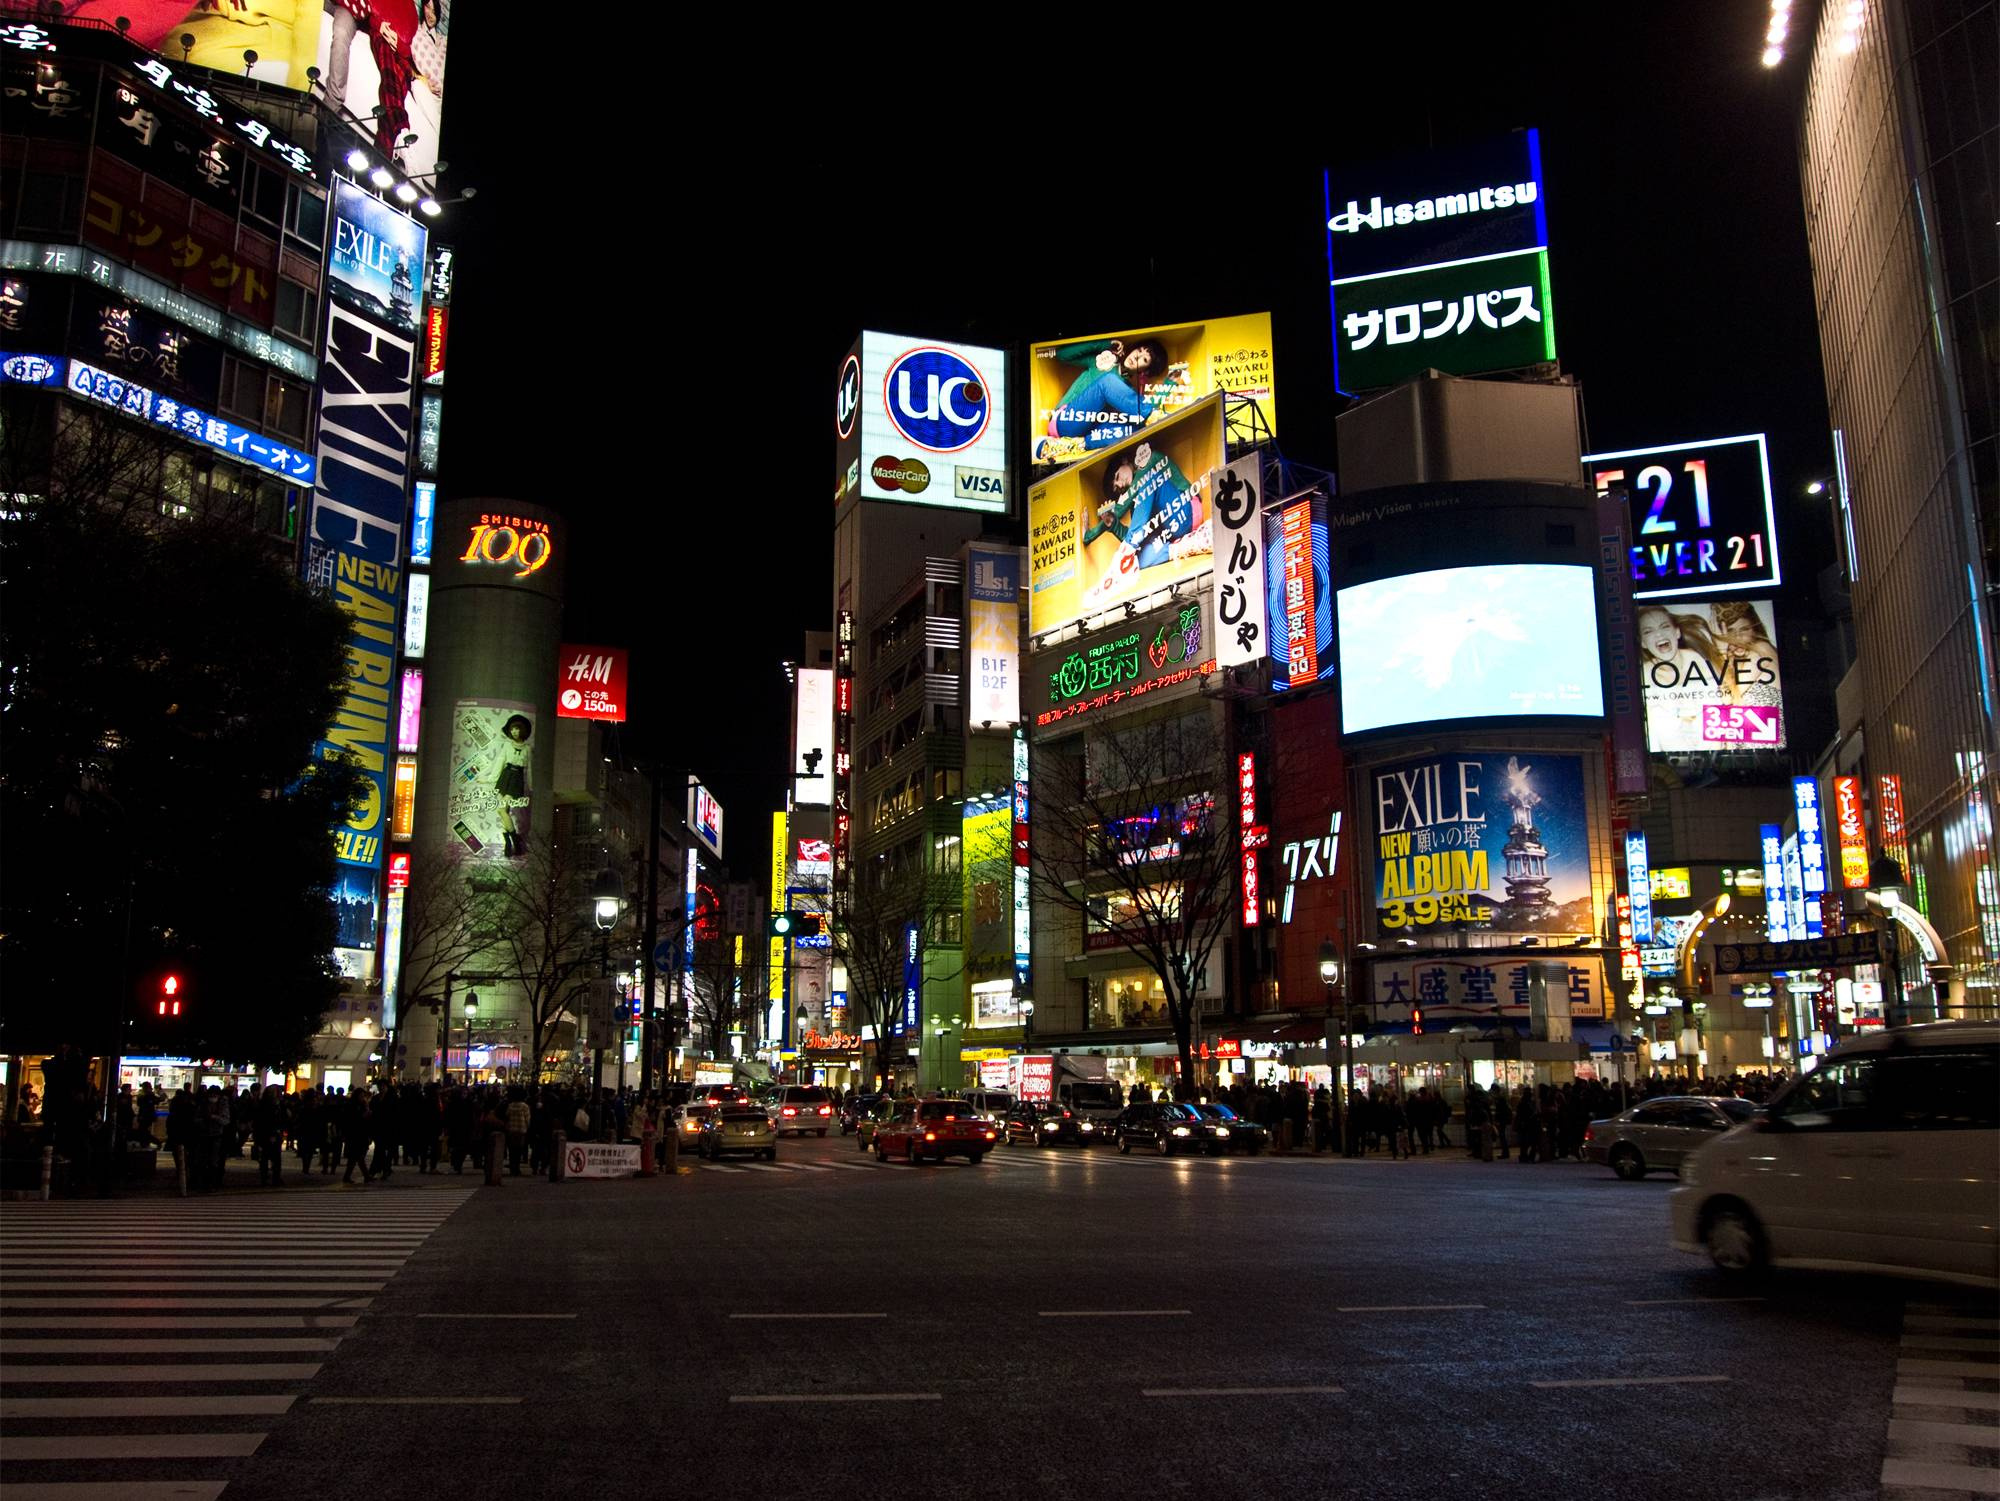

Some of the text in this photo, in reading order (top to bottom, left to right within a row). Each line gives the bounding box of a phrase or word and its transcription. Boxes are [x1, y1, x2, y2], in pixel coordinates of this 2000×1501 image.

[119, 88, 139, 107] 9F
[1327, 181, 1537, 233] Hisamitsu
[44, 251, 66, 267] 7F
[85, 191, 268, 302] コンタクト
[335, 217, 393, 277] EXILE
[91, 261, 110, 279] 7F
[1343, 286, 1540, 350] サロンパス
[1213, 363, 1269, 377] KAWARU
[1215, 375, 1269, 389] XYLISH
[897, 370, 981, 427] UC
[74, 365, 312, 476] AEON 英会話イーオン
[310, 298, 414, 567] EXILE
[873, 467, 929, 483] MasterCard
[961, 475, 1003, 494] VISA
[1130, 456, 1168, 494] KAWARU
[1132, 468, 1172, 506] XYLISH
[480, 514, 550, 534] SHIBUYA
[1333, 511, 1371, 529] Mighty
[1374, 501, 1412, 521] Vision
[459, 525, 552, 577] 109
[1033, 528, 1075, 555] KAWARU
[1727, 533, 1765, 570] 21
[338, 552, 399, 595] NEW
[1033, 545, 1075, 572] XYLISH
[1214, 469, 1259, 653] もんじゃ
[1283, 510, 1310, 677] 三千里薬品
[568, 653, 613, 685] H&M
[981, 657, 1007, 673] B1F
[1089, 647, 1140, 691] 西村
[583, 690, 608, 700] この先
[981, 675, 1007, 689] B2F
[583, 700, 617, 714] 150m
[1706, 706, 1745, 728] 3.5
[1705, 727, 1745, 740] OPEN
[1377, 762, 1487, 835] EXILE
[1381, 832, 1412, 859] NEW
[1796, 782, 1825, 892] 洋服の青山
[1383, 850, 1489, 899] ALBUM
[1382, 893, 1470, 929] 3.9 ON
[1440, 906, 1492, 923] SALE
[803, 1028, 861, 1049] グルメタウン
